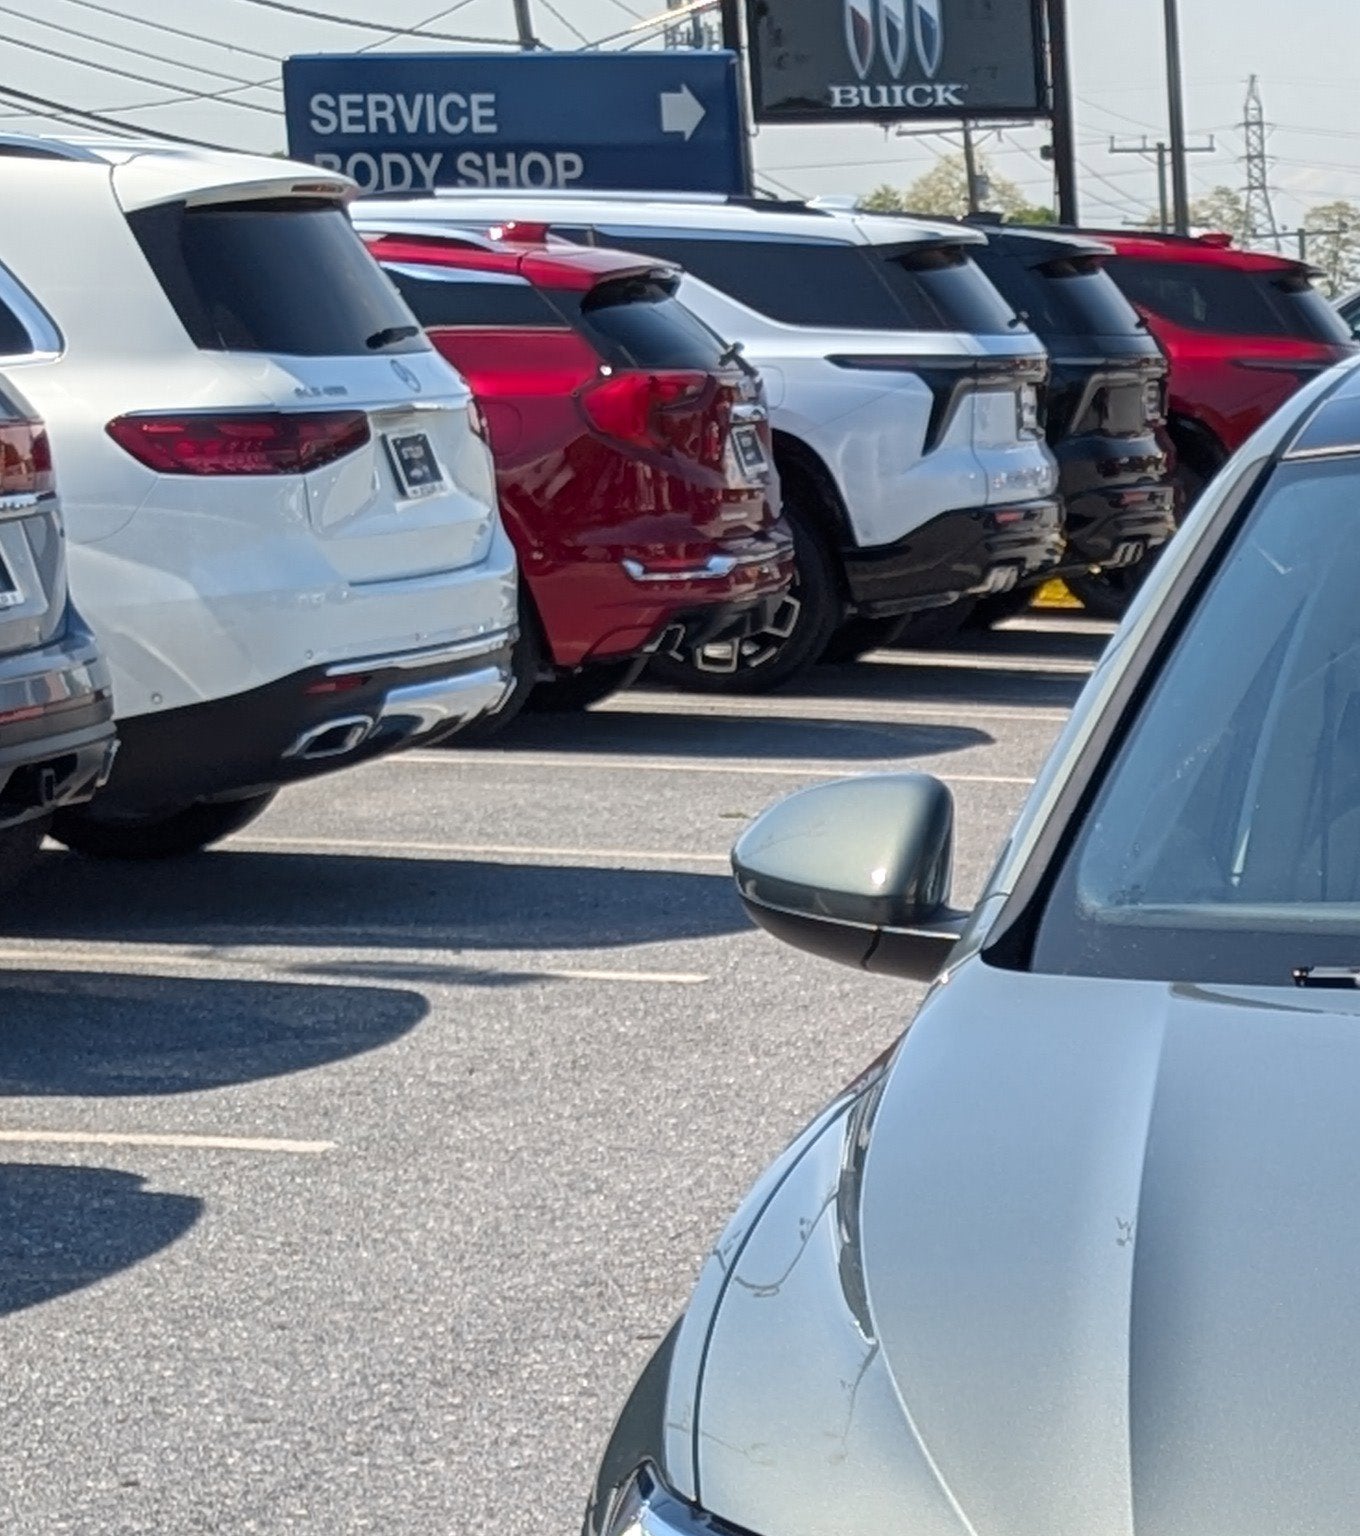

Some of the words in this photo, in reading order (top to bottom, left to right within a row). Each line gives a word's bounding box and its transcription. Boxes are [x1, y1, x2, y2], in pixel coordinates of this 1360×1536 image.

[309, 92, 498, 134] SERVICE
[829, 83, 965, 108] BUICK
[456, 152, 584, 189] SHOP
